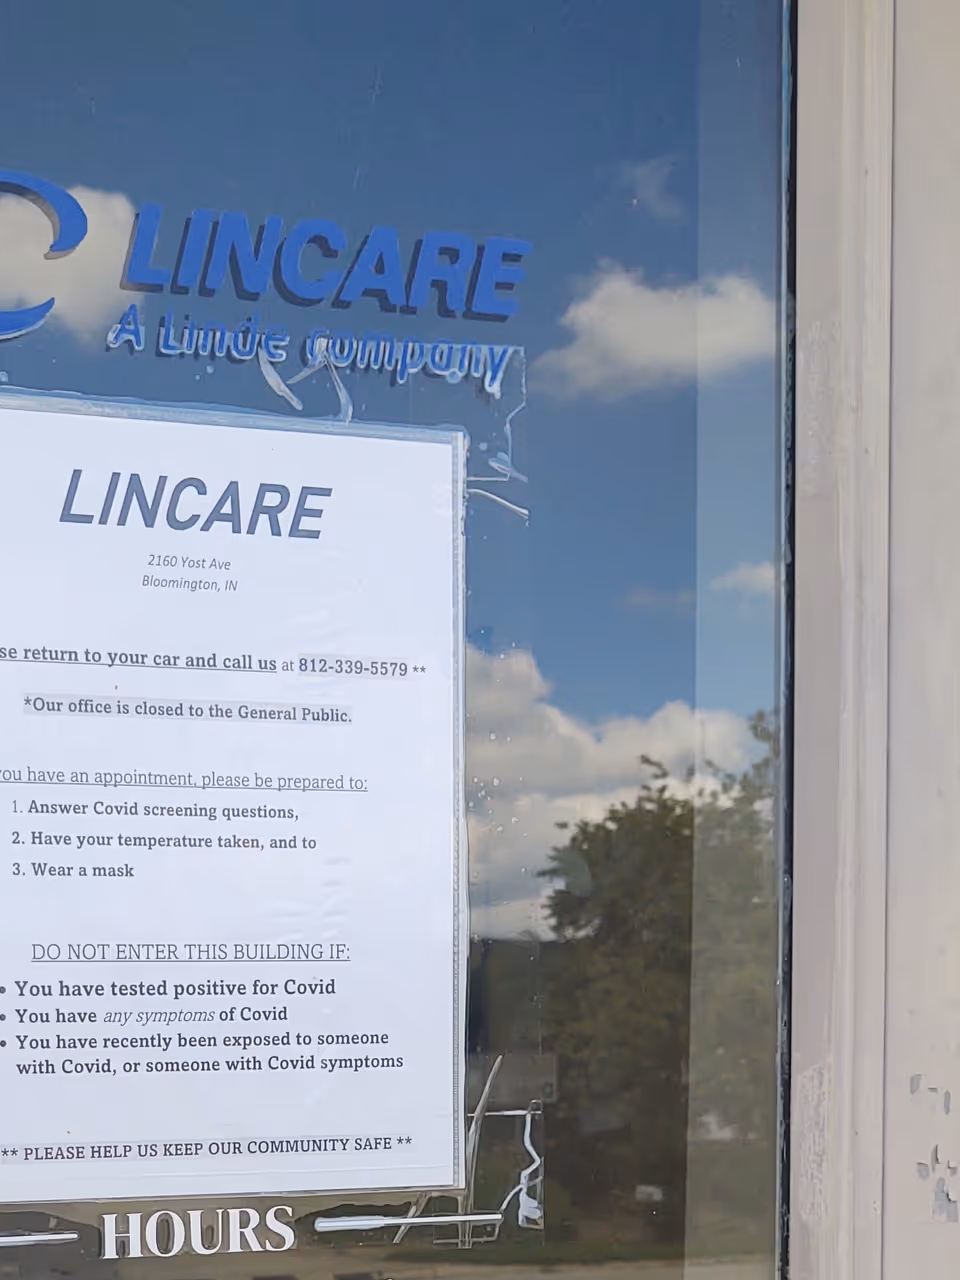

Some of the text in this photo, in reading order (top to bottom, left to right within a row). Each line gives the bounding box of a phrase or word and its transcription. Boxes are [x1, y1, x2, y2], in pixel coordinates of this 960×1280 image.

[123, 203, 533, 320] LINCARE
[108, 303, 510, 394] A Linde company
[59, 468, 333, 540] LINCARE
[147, 553, 231, 571] 2160 Yost Ave
[142, 574, 238, 593] Bloomington, IN
[23, 646, 79, 662] return
[84, 648, 102, 663] to
[107, 652, 149, 668] your
[153, 654, 181, 667] car
[185, 652, 218, 668] and
[222, 654, 253, 670] call
[257, 659, 277, 671] us
[281, 660, 295, 672] at
[298, 657, 408, 677] 812-339-5579
[68, 698, 112, 714] office
[116, 700, 130, 715] is
[134, 701, 184, 717] closed
[188, 704, 204, 718] to
[208, 703, 233, 719] the
[237, 704, 297, 721] General
[301, 707, 352, 723] Public.
[26, 765, 65, 783] have
[70, 771, 89, 784] an
[201, 771, 250, 790] please
[254, 772, 273, 788] be
[277, 774, 345, 793] prepared
[349, 776, 368, 790] to:
[12, 799, 299, 822] 1. Answer Covid screening questions,
[11, 830, 317, 852] 2. Have your temperature taken, and to
[12, 862, 135, 878] 3. Wear a mask
[31, 943, 350, 960] DO NOT ENTER THIS BUILDING IF:
[14, 978, 336, 1000] You have tested positive for Covid
[14, 1006, 288, 1027] You have any symptoms of Covid
[15, 1031, 389, 1052] You have recently been exposed to someone
[15, 1054, 404, 1077] with Covid, or someone with Covid symptoms
[24, 1137, 392, 1161] PLEASE HELP US KEEP OUR COMMUNITY SAFE
[101, 1205, 295, 1260] HOURS
